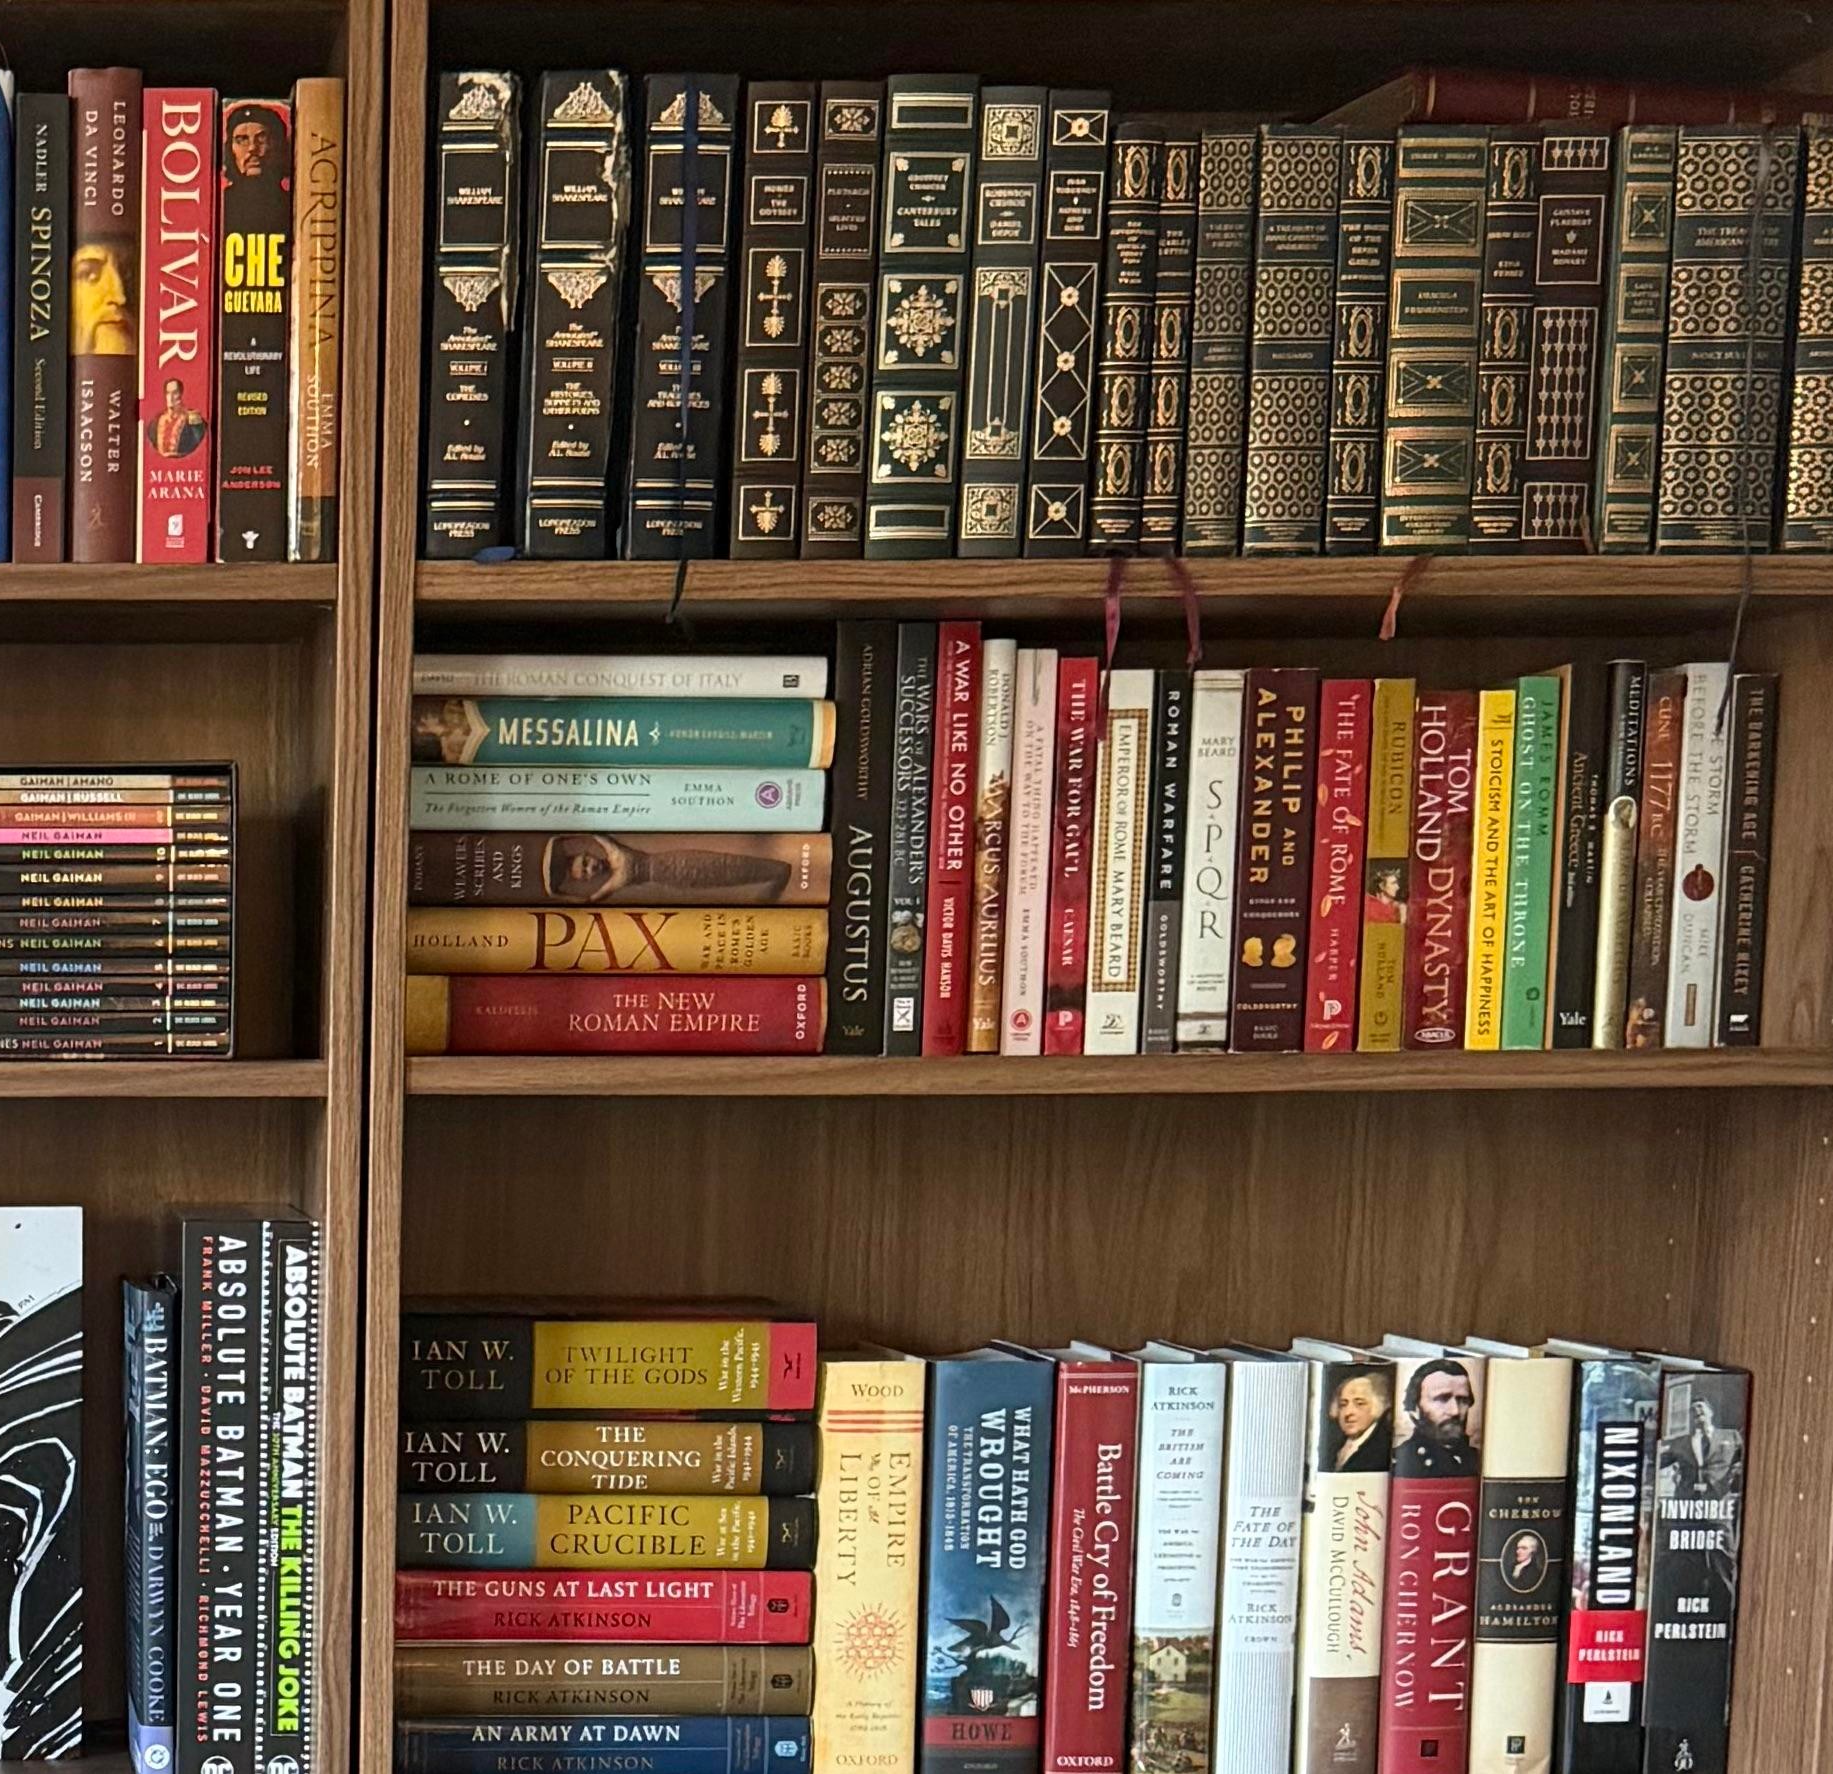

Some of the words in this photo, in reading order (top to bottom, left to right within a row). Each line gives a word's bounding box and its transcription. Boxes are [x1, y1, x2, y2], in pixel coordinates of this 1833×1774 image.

[158, 101, 209, 370] BOLÍVAR
[225, 233, 285, 287] CHE
[30, 208, 52, 341] SPINOZA
[224, 291, 282, 313] GUEVARA
[148, 487, 205, 499] ARANA
[150, 471, 204, 484] MARIE
[498, 720, 639, 747] MESSALINA
[425, 774, 436, 785] A
[445, 774, 502, 785] ROME
[511, 774, 533, 785] OF
[603, 773, 651, 785] OWN
[1416, 704, 1446, 862] HOLLAND
[1448, 748, 1470, 814] TOM
[22, 851, 48, 859] NEIL
[52, 851, 103, 859] GAIMAN
[413, 934, 508, 948] HOLLAND
[527, 912, 679, 969] PAX
[841, 825, 872, 1002] AUGUSTUS
[1423, 867, 1454, 1025] DYNASTY
[568, 1013, 660, 1032] ROMAN
[668, 1013, 760, 1033] EMPIRE
[613, 994, 650, 1008] THE
[658, 993, 714, 1009] NEW
[795, 984, 806, 1040] OXFORD
[1559, 1012, 1586, 1026] Yale
[217, 1236, 249, 1404] ABSOLUTE
[216, 1424, 245, 1553] BATMAN
[976, 1410, 1007, 1567] WROUGHT
[1095, 1443, 1124, 1514] Battle
[281, 1505, 302, 1553] THE
[1088, 1520, 1121, 1563] Cry
[1596, 1427, 1639, 1604] NIXONLAND
[279, 1559, 304, 1661] KILLING
[434, 1581, 479, 1598] THE
[486, 1581, 545, 1598] GUNS
[552, 1581, 580, 1598] AT
[587, 1581, 639, 1598] LAST
[646, 1581, 713, 1598] LIGHT
[1091, 1572, 1117, 1597] of
[1428, 1500, 1474, 1713] GRANT
[213, 1583, 246, 1664] YEAR
[1088, 1599, 1117, 1712] Freedom
[212, 1681, 241, 1742] ONE
[278, 1666, 302, 1732] JOKE
